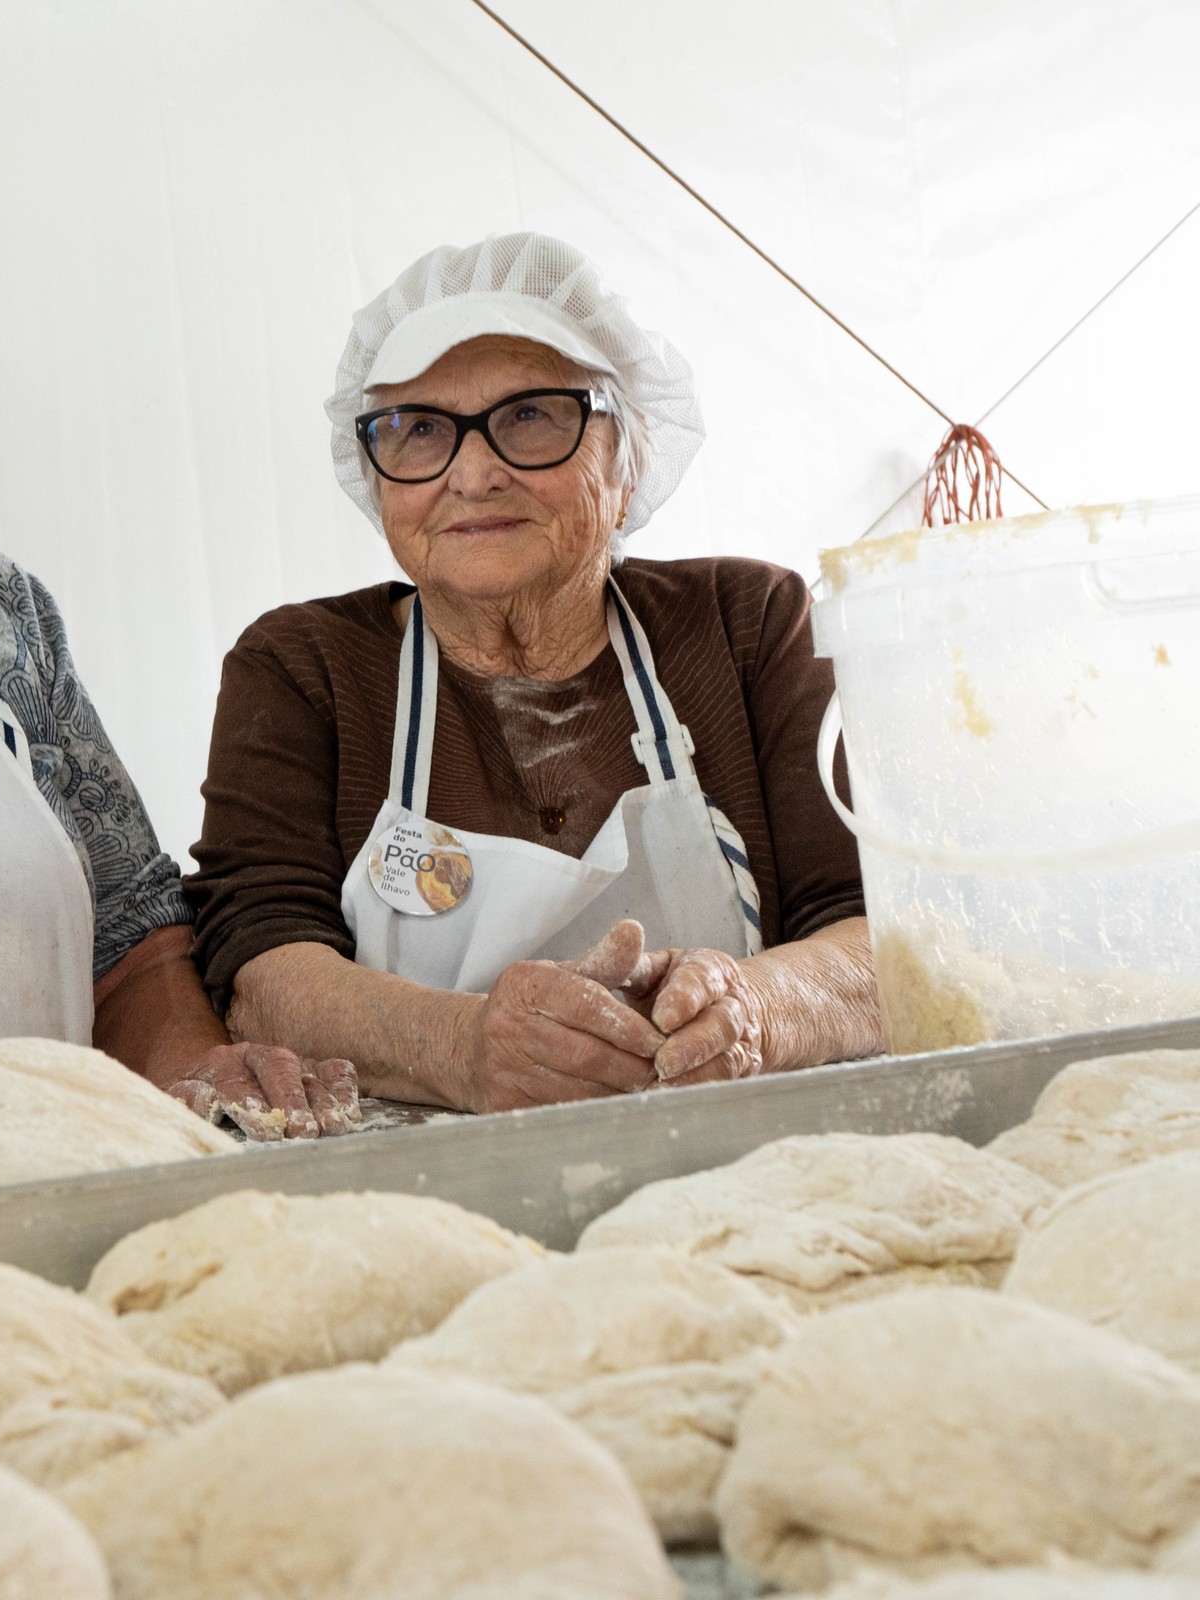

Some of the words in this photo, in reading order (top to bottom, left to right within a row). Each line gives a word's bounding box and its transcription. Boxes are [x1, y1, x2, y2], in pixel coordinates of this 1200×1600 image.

[395, 826, 422, 839] Festa
[393, 834, 406, 842] do
[385, 865, 406, 877] Vale
[383, 873, 395, 882] de
